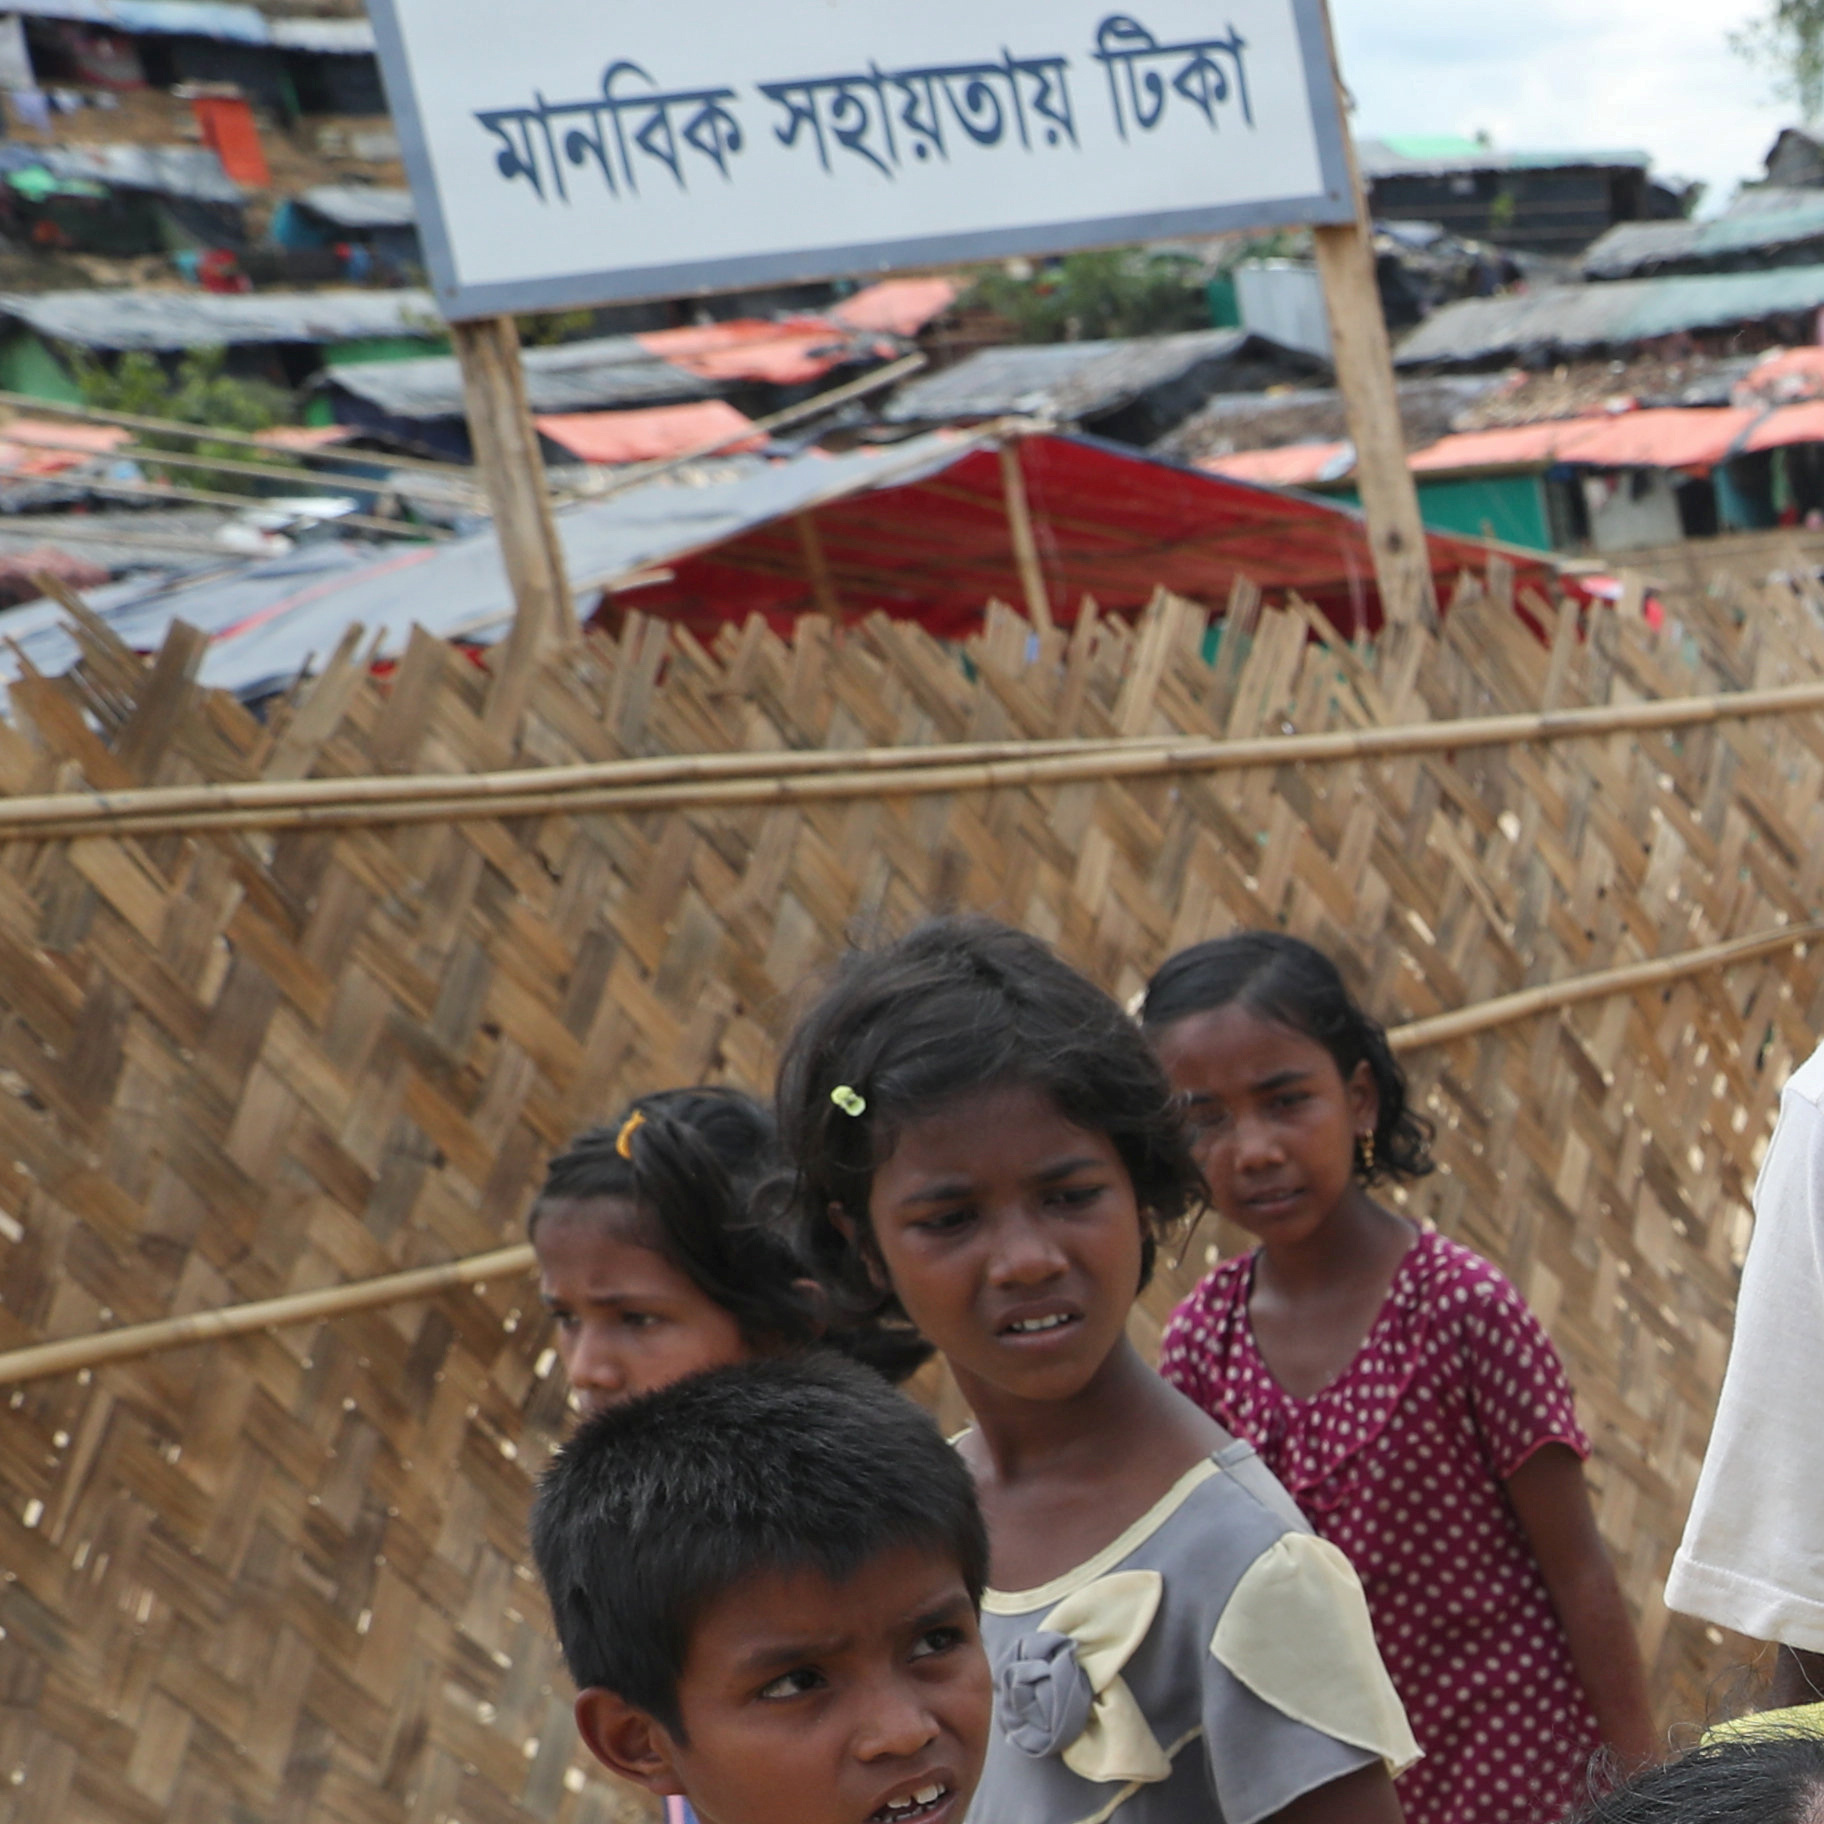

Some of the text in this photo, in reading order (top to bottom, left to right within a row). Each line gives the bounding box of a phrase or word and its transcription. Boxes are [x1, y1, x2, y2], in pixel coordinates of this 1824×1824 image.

[474, 16, 1254, 204] মানবিক সহায়তায় টিকা
